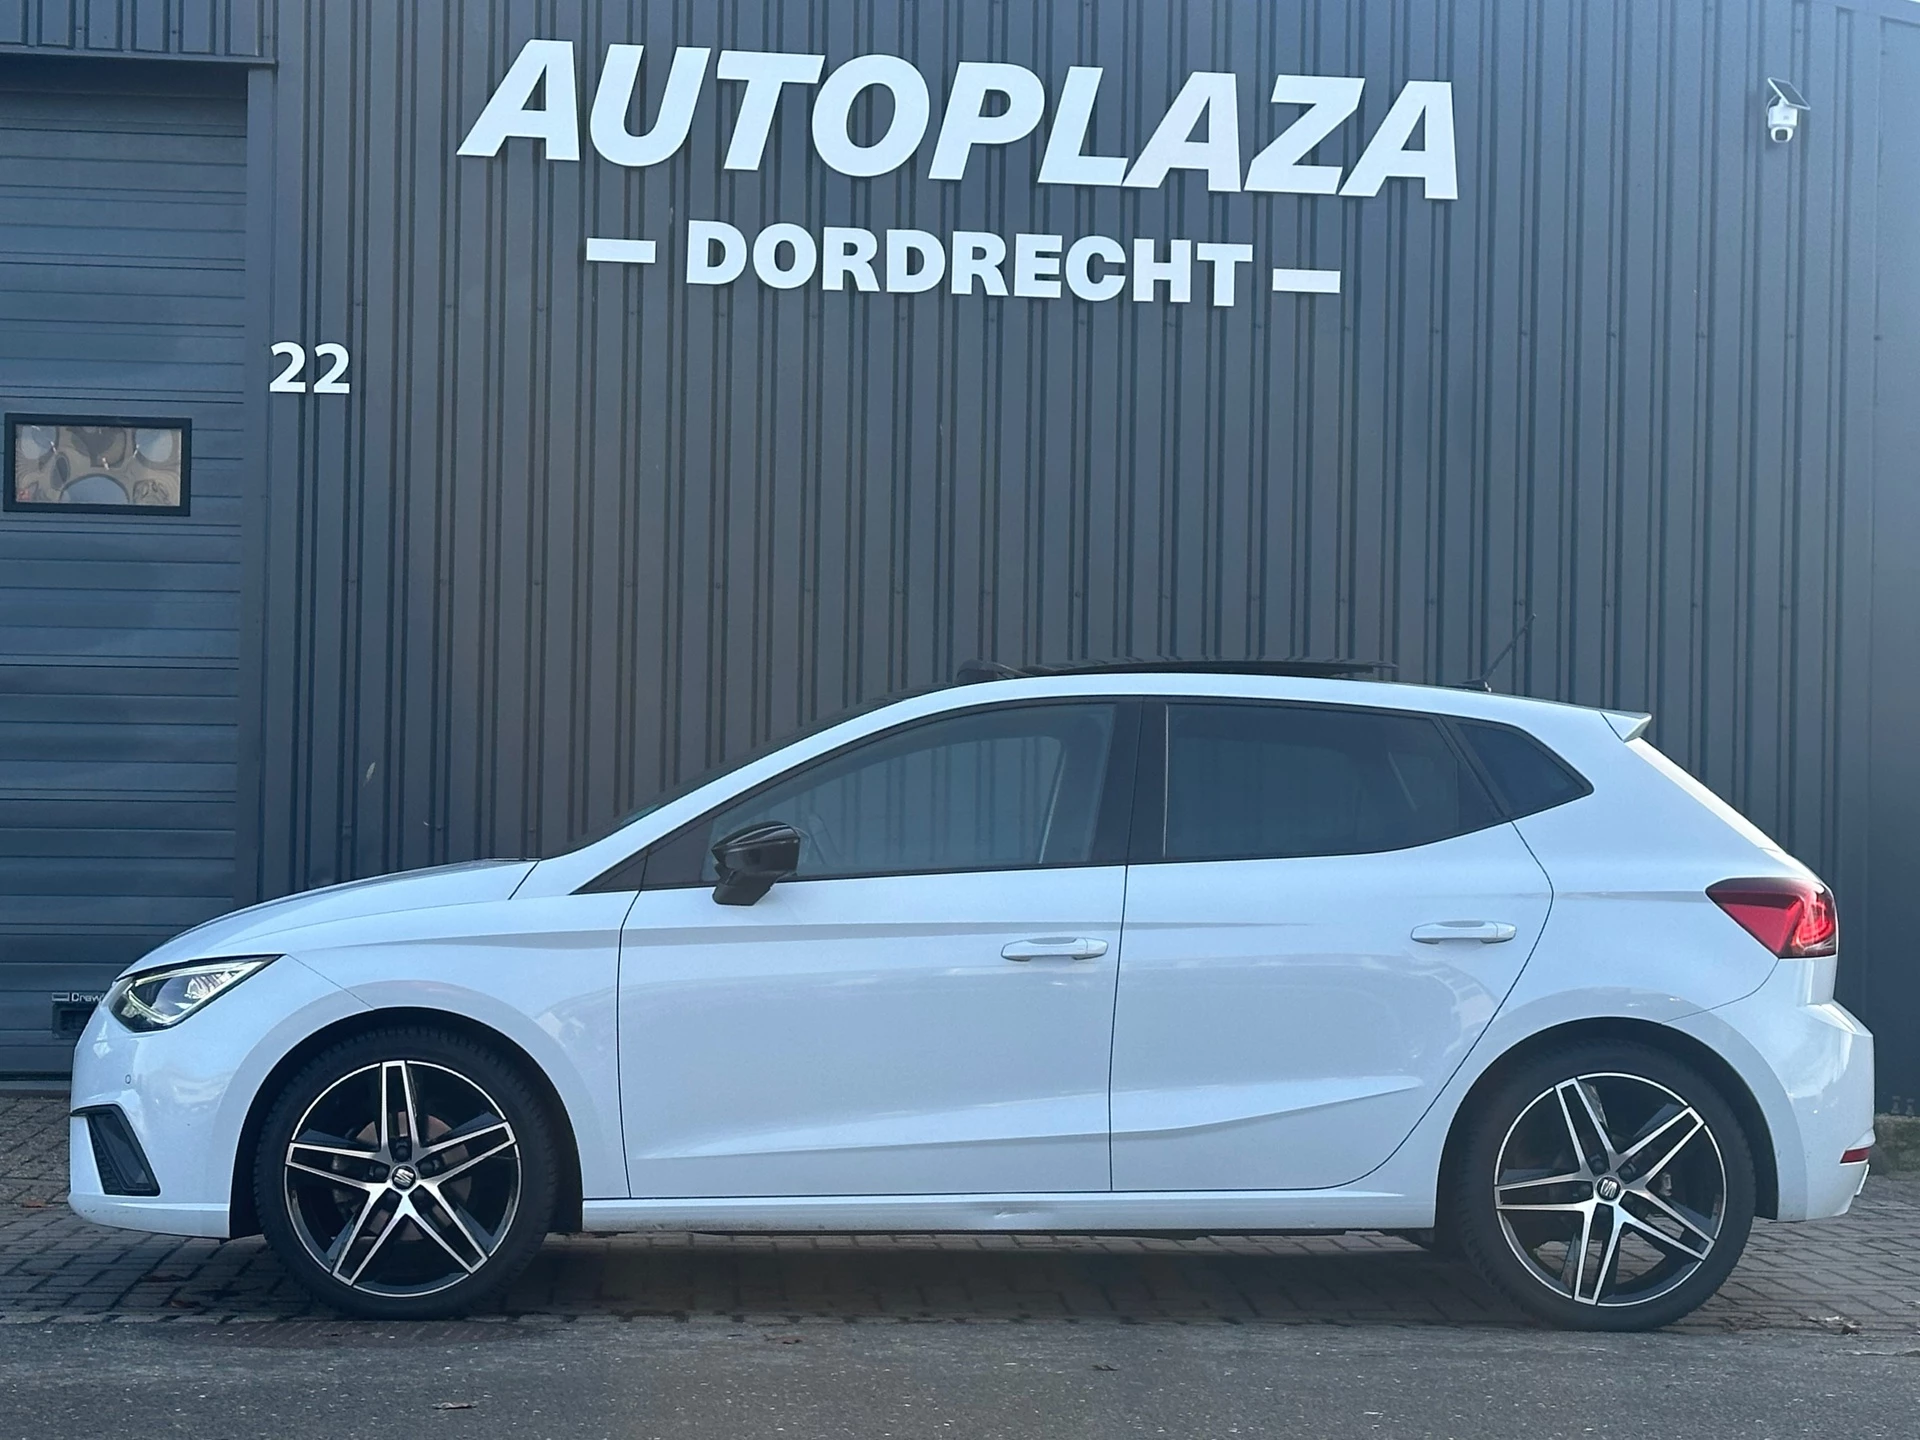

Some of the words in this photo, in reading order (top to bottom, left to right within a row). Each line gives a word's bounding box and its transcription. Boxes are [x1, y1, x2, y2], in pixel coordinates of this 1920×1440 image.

[457, 40, 1458, 200] AUTOPLAZA
[686, 221, 1253, 307] DORDRECHT
[269, 342, 350, 394] 22
